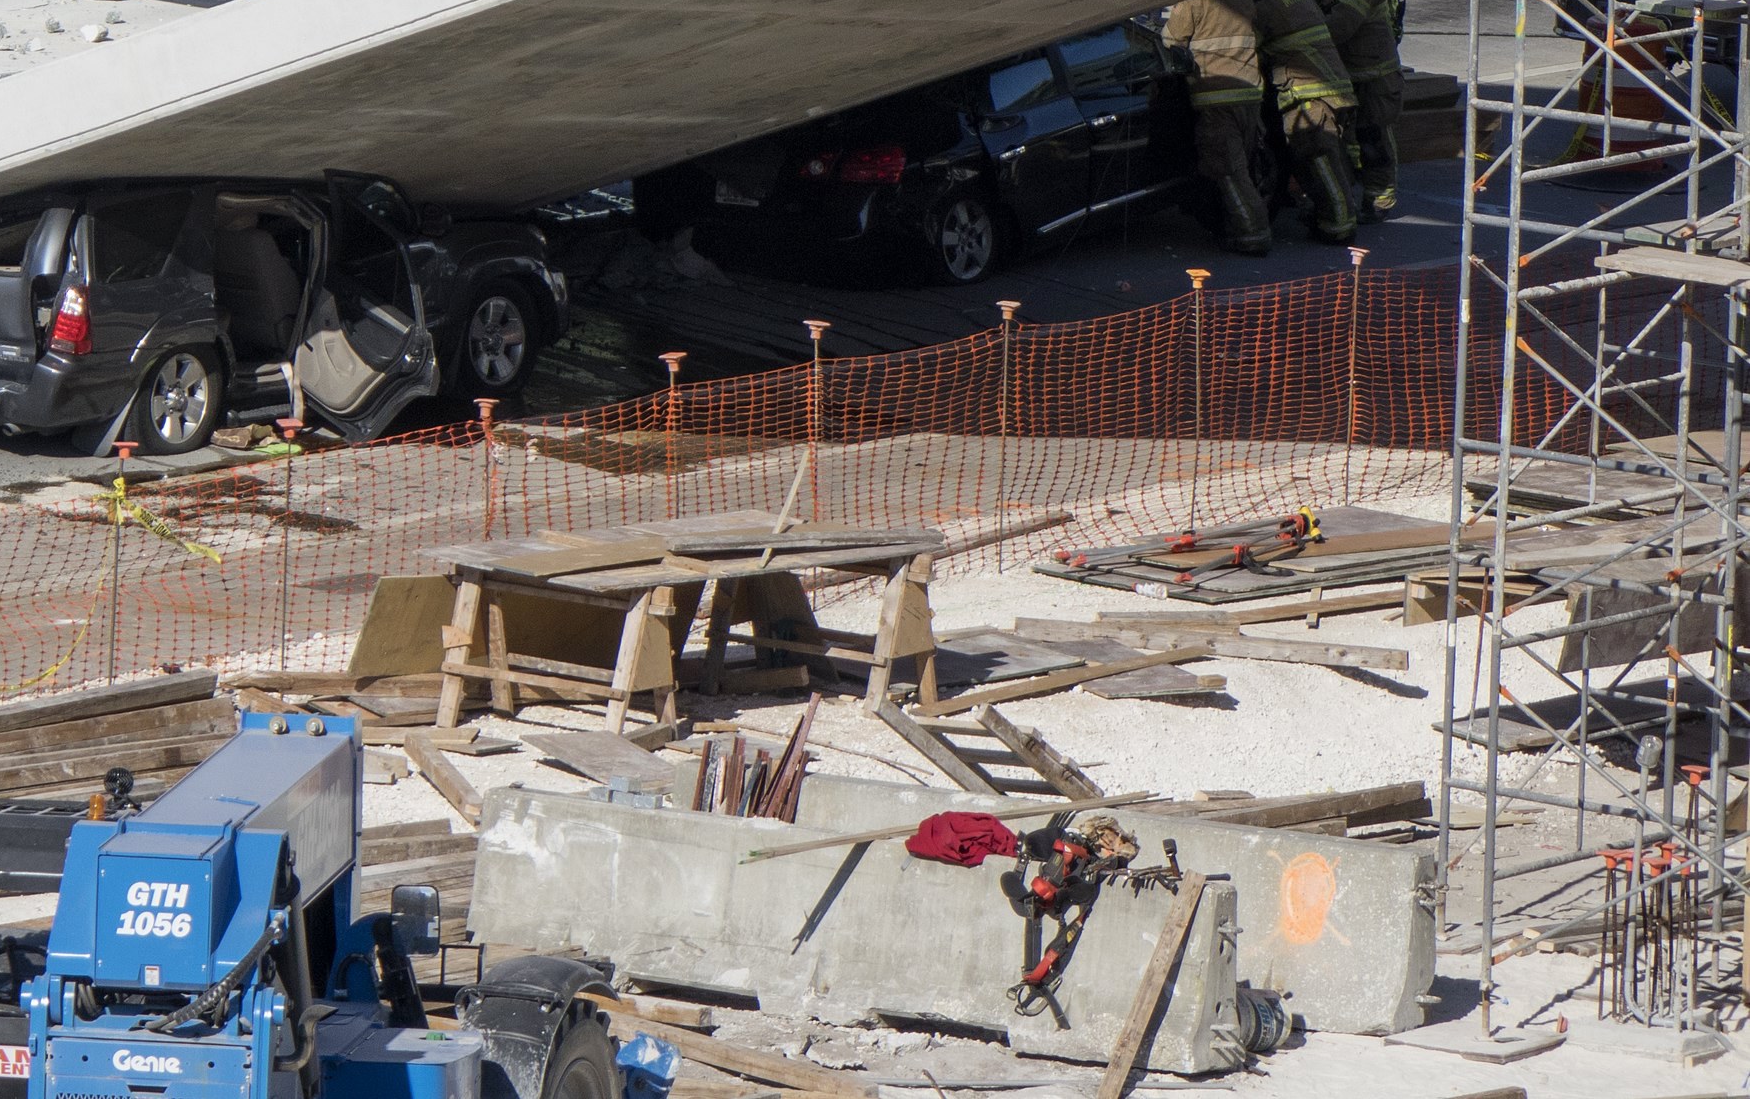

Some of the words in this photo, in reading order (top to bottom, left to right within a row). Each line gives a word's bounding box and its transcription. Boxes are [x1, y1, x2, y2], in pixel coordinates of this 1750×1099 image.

[126, 881, 189, 908] GTH
[116, 910, 192, 937] 1056
[112, 1049, 182, 1074] Genie
